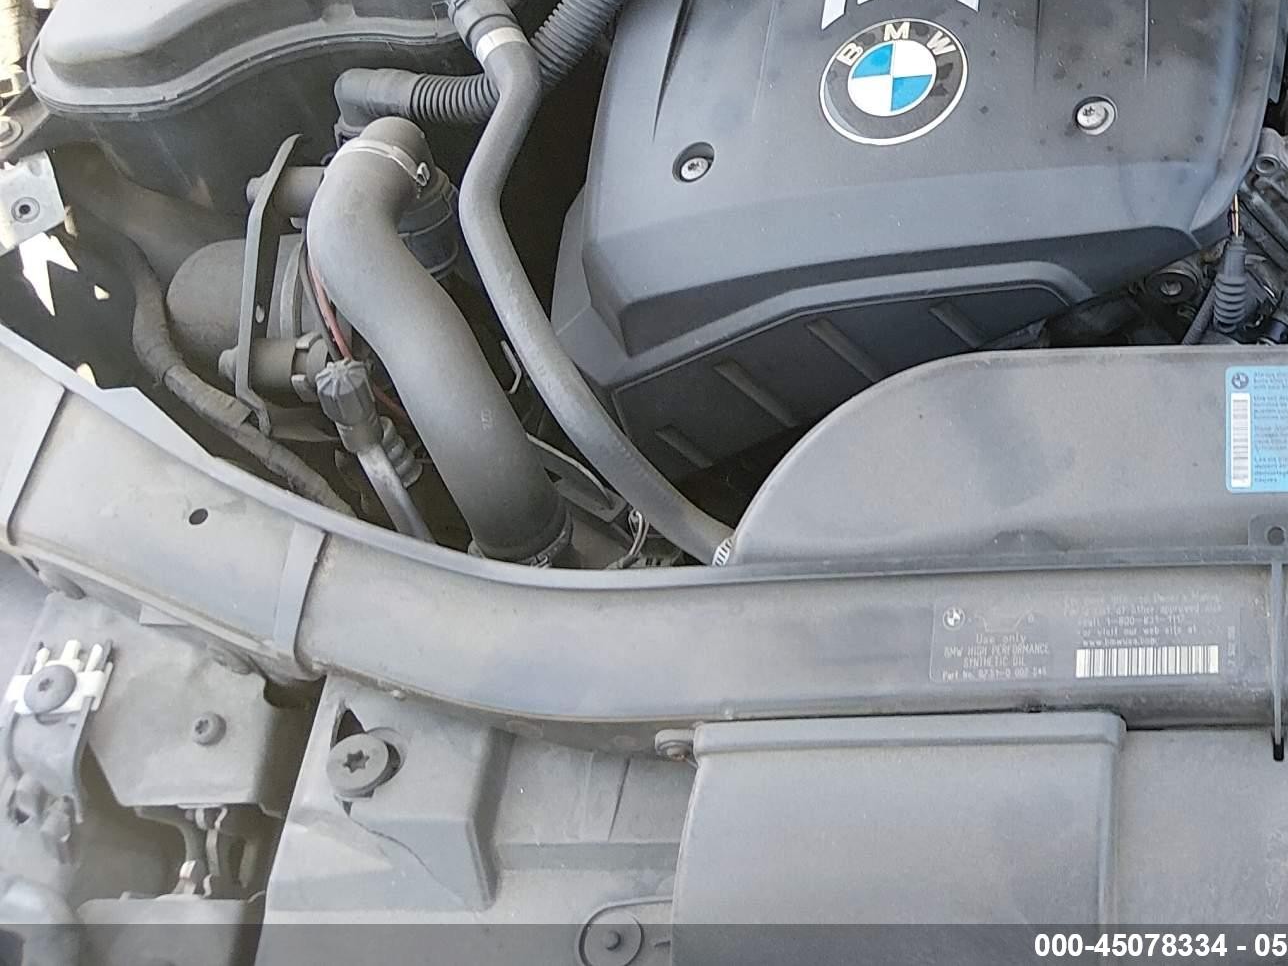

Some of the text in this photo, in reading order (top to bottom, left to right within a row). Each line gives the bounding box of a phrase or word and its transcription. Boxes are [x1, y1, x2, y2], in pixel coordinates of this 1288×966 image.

[836, 21, 956, 66] BMW
[976, 632, 1028, 645] Use only
[991, 642, 1050, 656] PERFORMANCE
[963, 656, 1009, 669] SYNTHETIC
